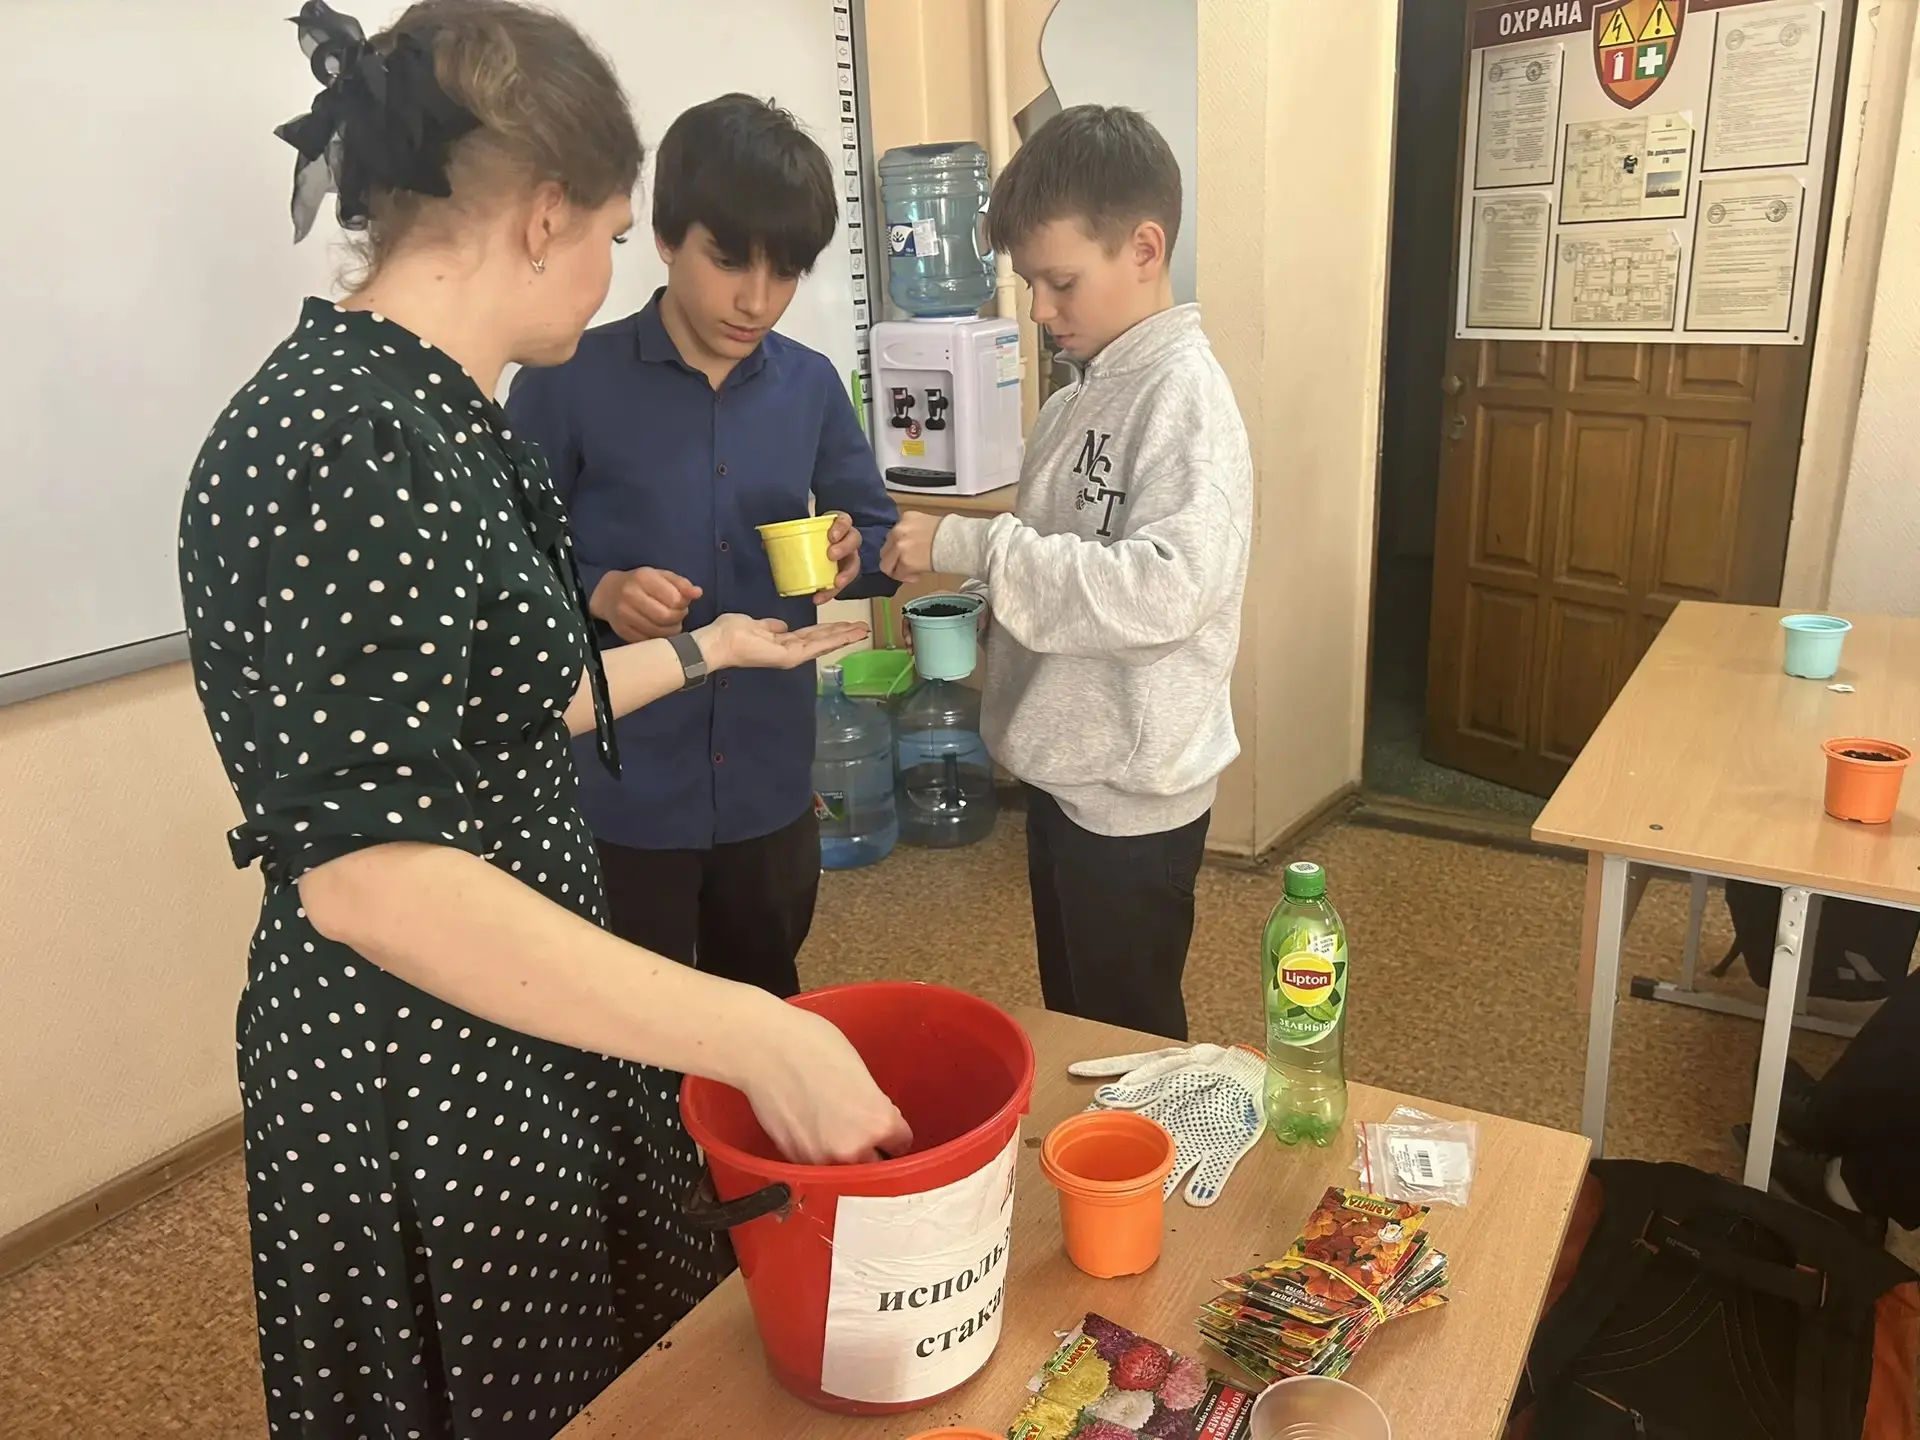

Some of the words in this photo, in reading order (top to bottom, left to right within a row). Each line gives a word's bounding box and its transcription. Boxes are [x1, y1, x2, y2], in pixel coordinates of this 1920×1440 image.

[1500, 0, 1583, 36] ОХРАНА
[1286, 971, 1328, 986] Lipton
[1348, 1198, 1393, 1216] АЭЛИТА
[1206, 1400, 1228, 1433] РАЗМЕР
